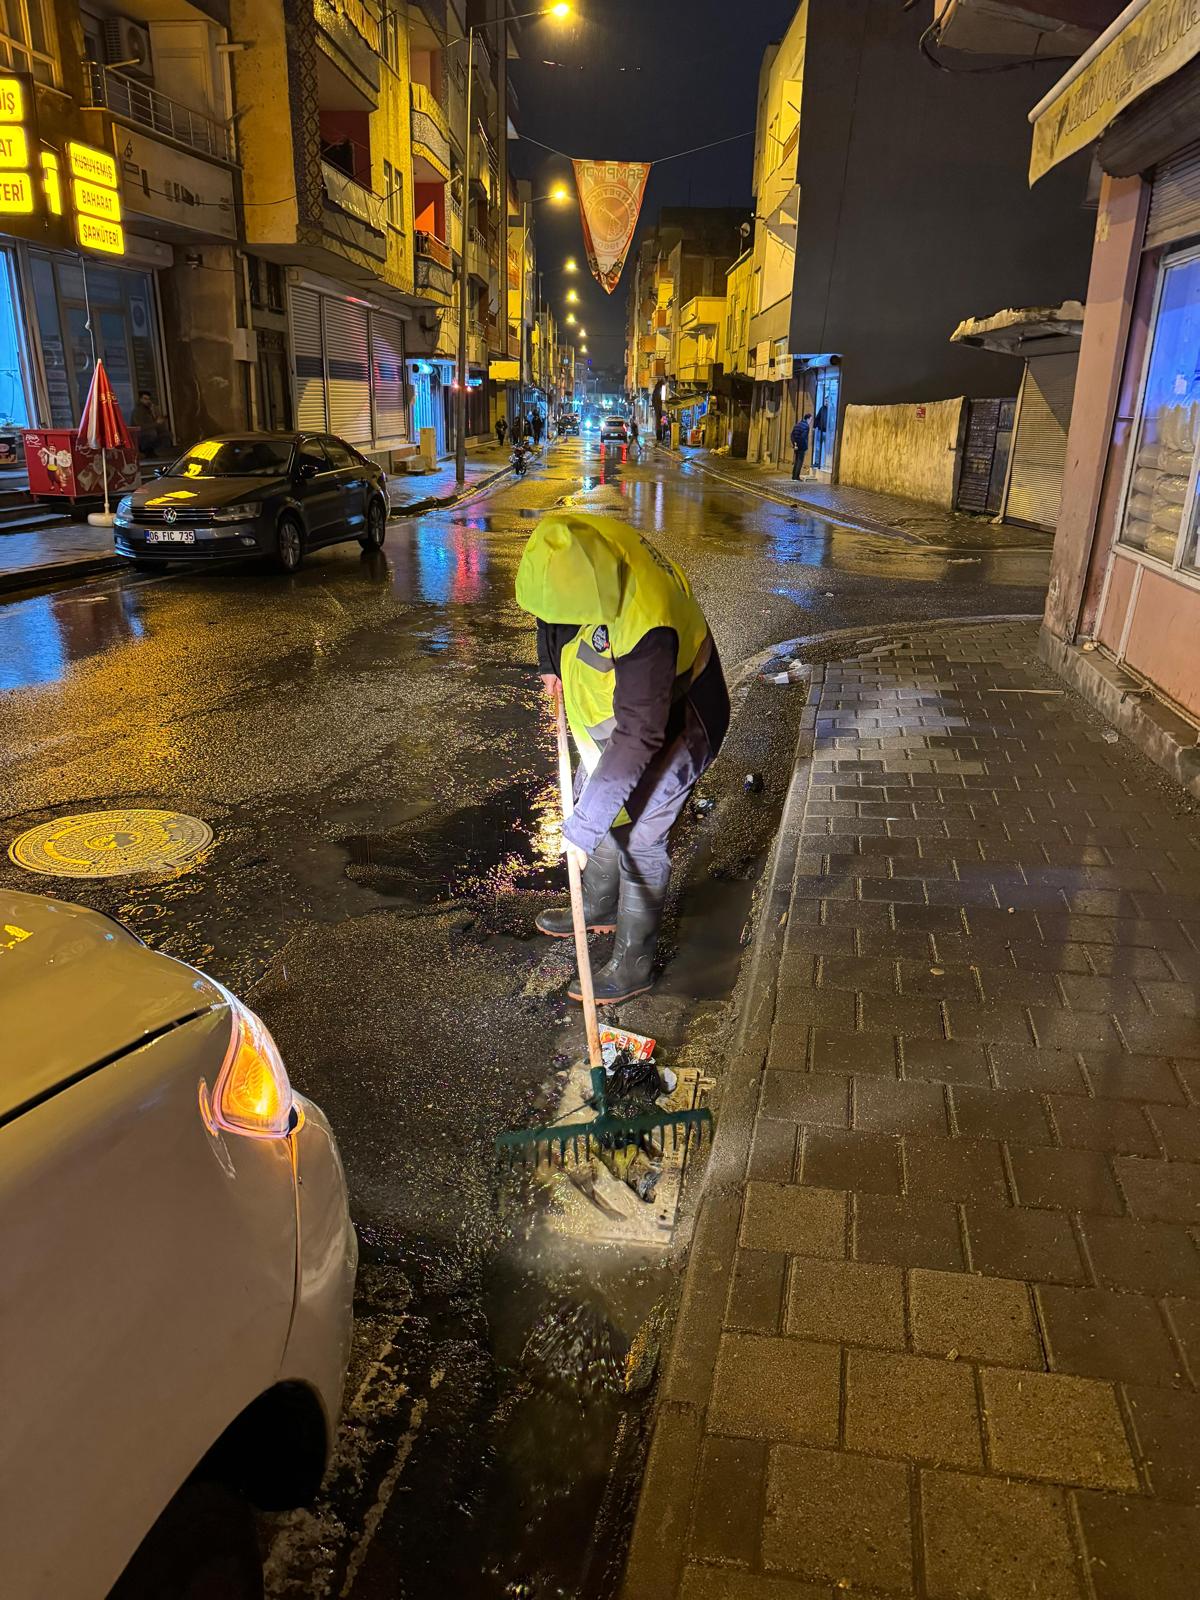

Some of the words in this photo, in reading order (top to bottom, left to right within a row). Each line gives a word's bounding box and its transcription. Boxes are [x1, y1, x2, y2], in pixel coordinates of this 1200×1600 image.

[0, 88, 16, 114] İŞ
[81, 189, 113, 212] BAHARAT
[83, 223, 119, 247] ŞARKÜTERİ
[150, 531, 159, 541] 06
[162, 531, 175, 541] FIC
[179, 531, 194, 541] 735
